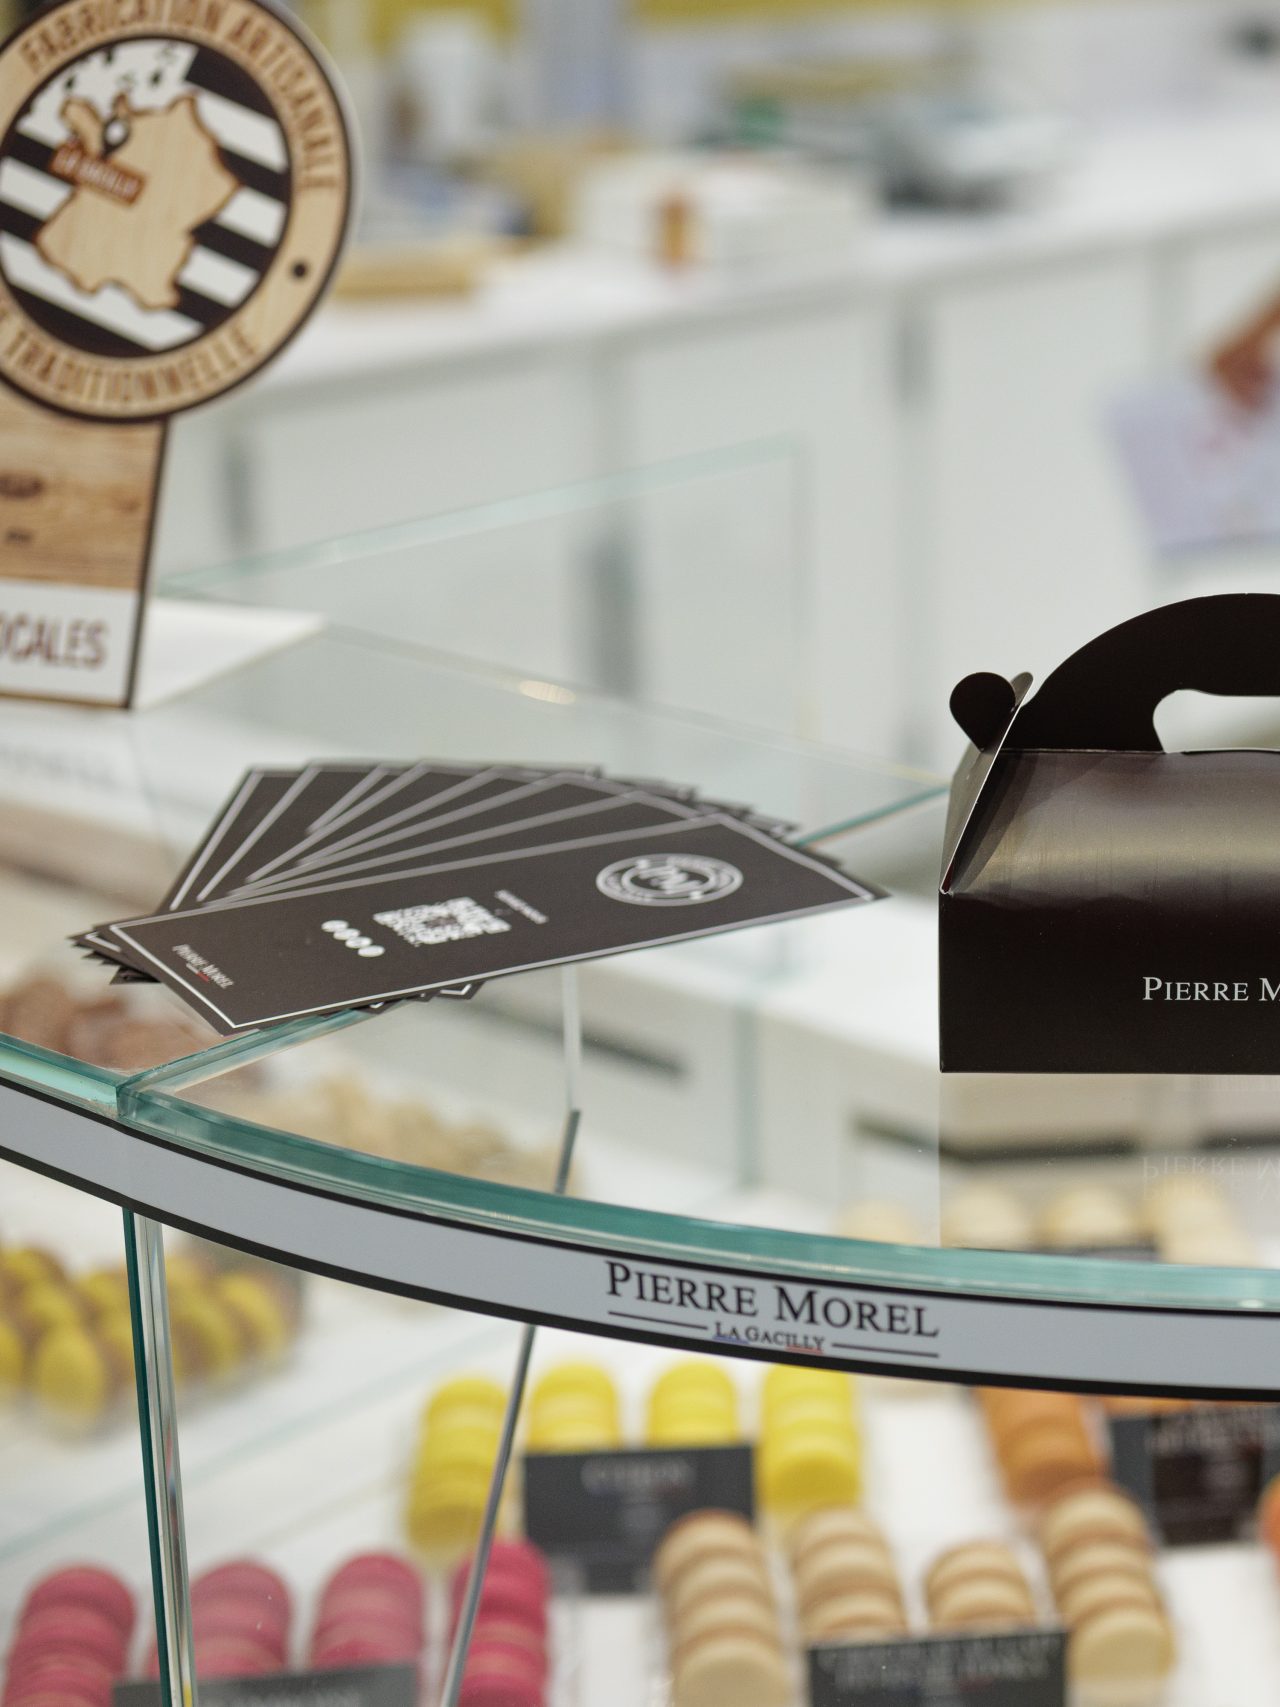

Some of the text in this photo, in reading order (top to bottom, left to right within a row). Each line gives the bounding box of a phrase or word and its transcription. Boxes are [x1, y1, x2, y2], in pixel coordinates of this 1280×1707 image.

[226, 15, 338, 190] ARTISANALE
[5, 327, 256, 402] TRADITIONNELLE
[0, 612, 108, 670] OCALES
[1143, 976, 1250, 1001] PIERRE
[604, 1260, 940, 1338] PIERRE MOREL
[715, 1321, 825, 1351] LA GACILLY
